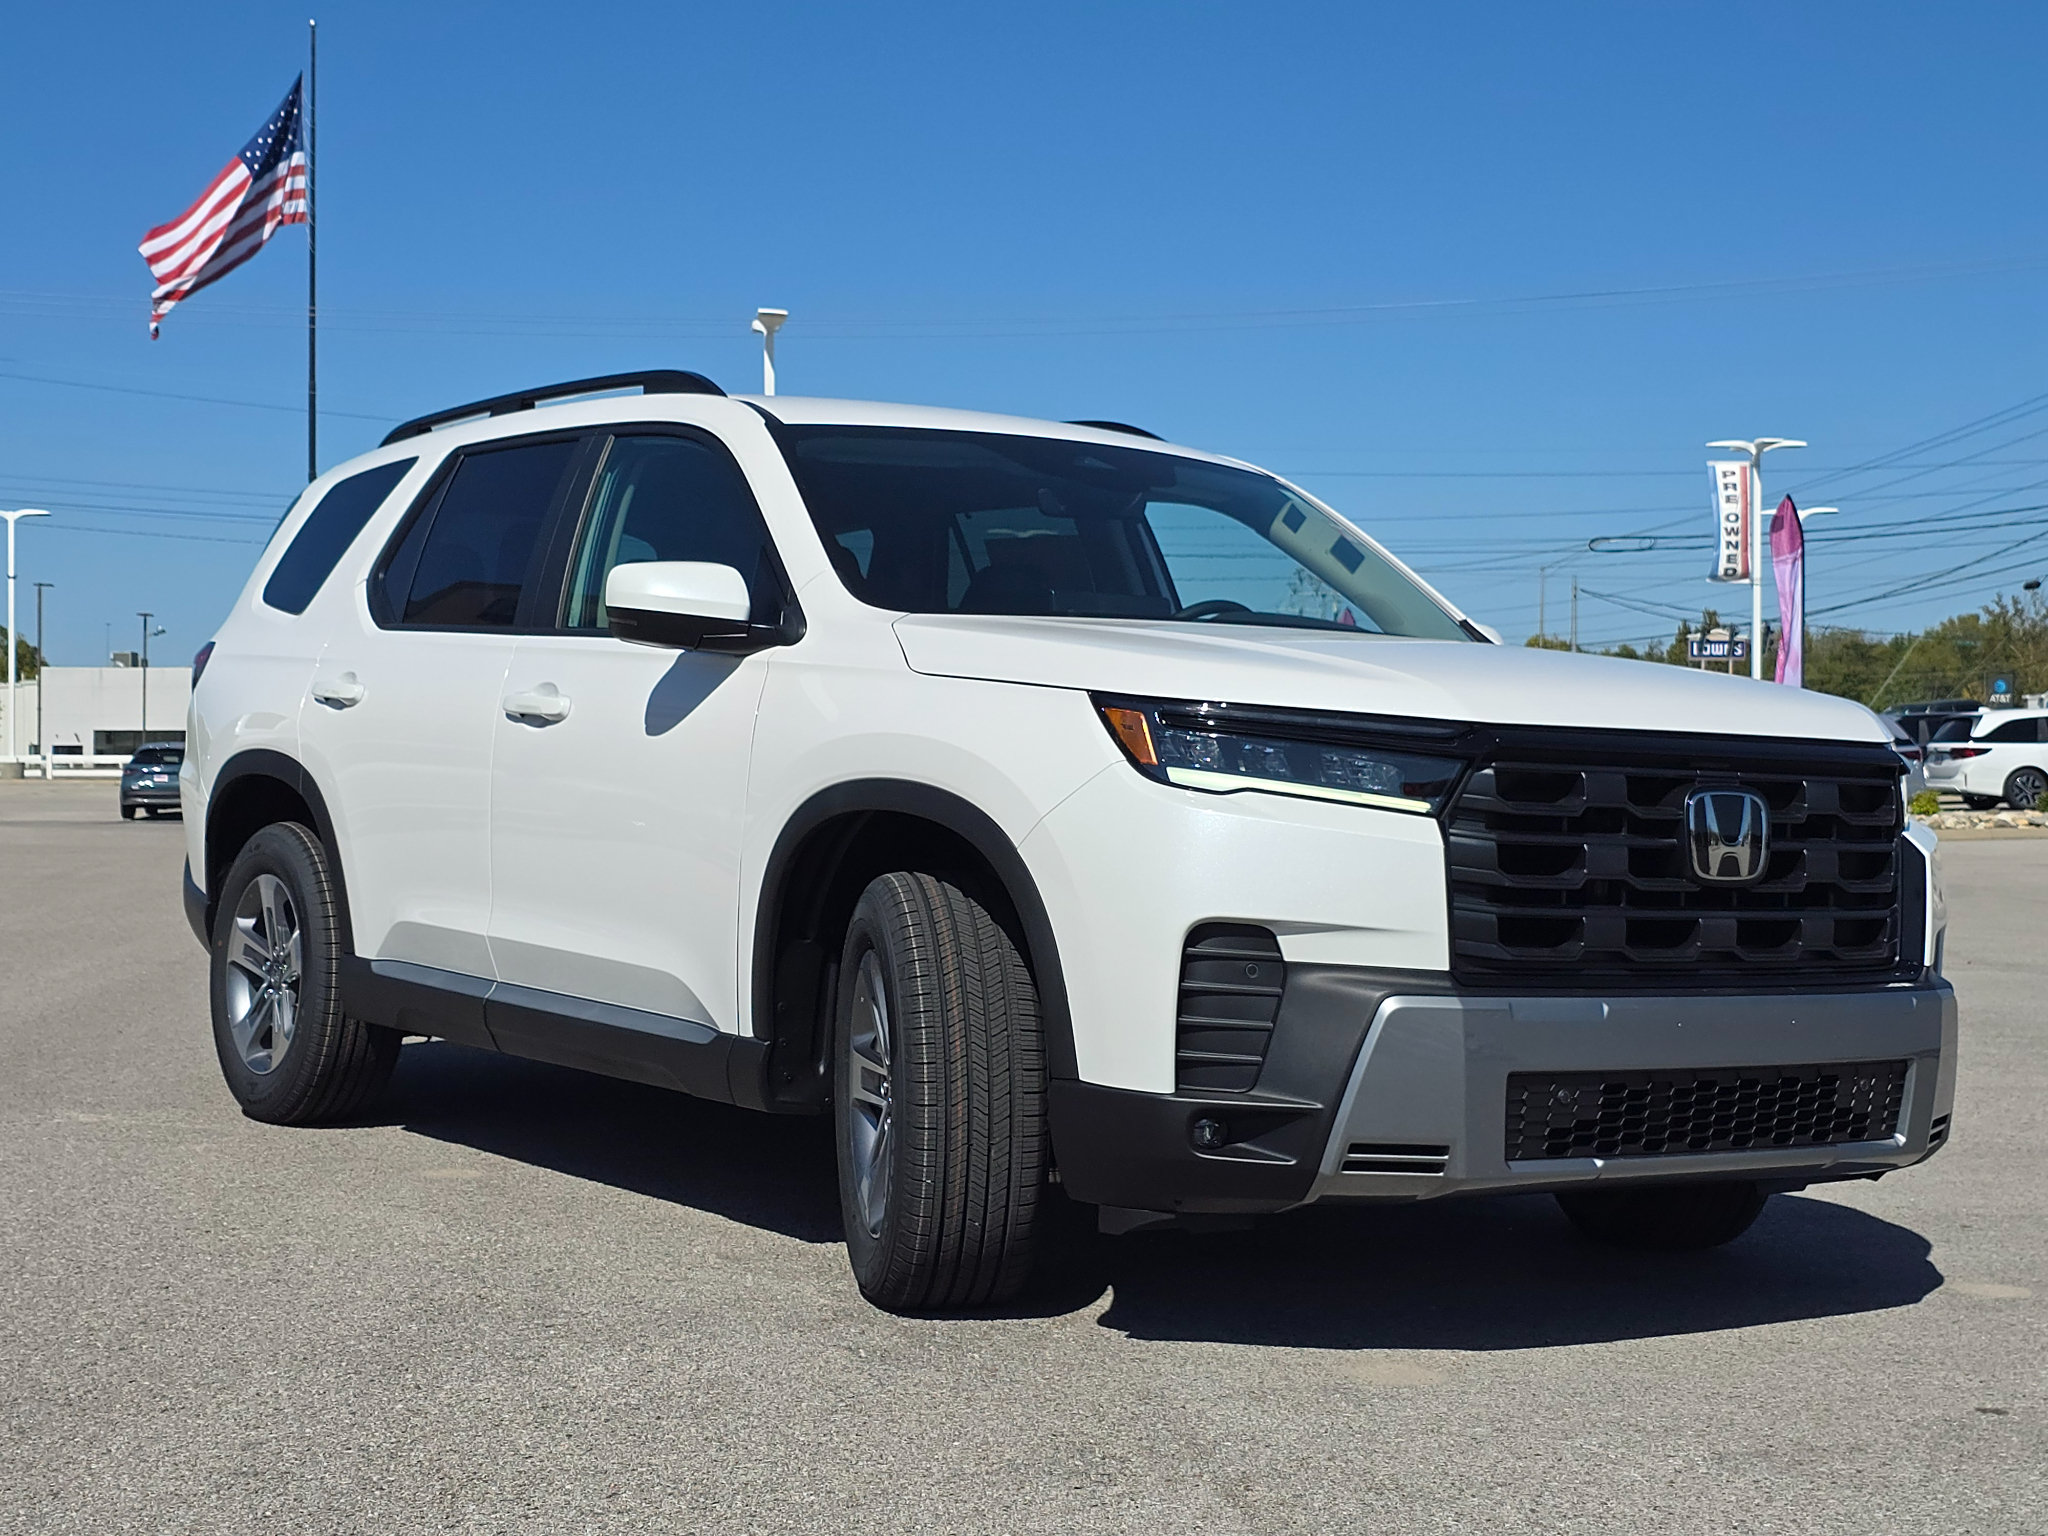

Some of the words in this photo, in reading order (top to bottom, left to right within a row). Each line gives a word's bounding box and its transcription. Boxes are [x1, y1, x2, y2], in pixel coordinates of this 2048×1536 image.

[1722, 470, 1738, 504] PRE
[1724, 512, 1740, 577] OWNED
[1692, 642, 1743, 656] LOWS
[1990, 693, 2011, 703] AT&T
